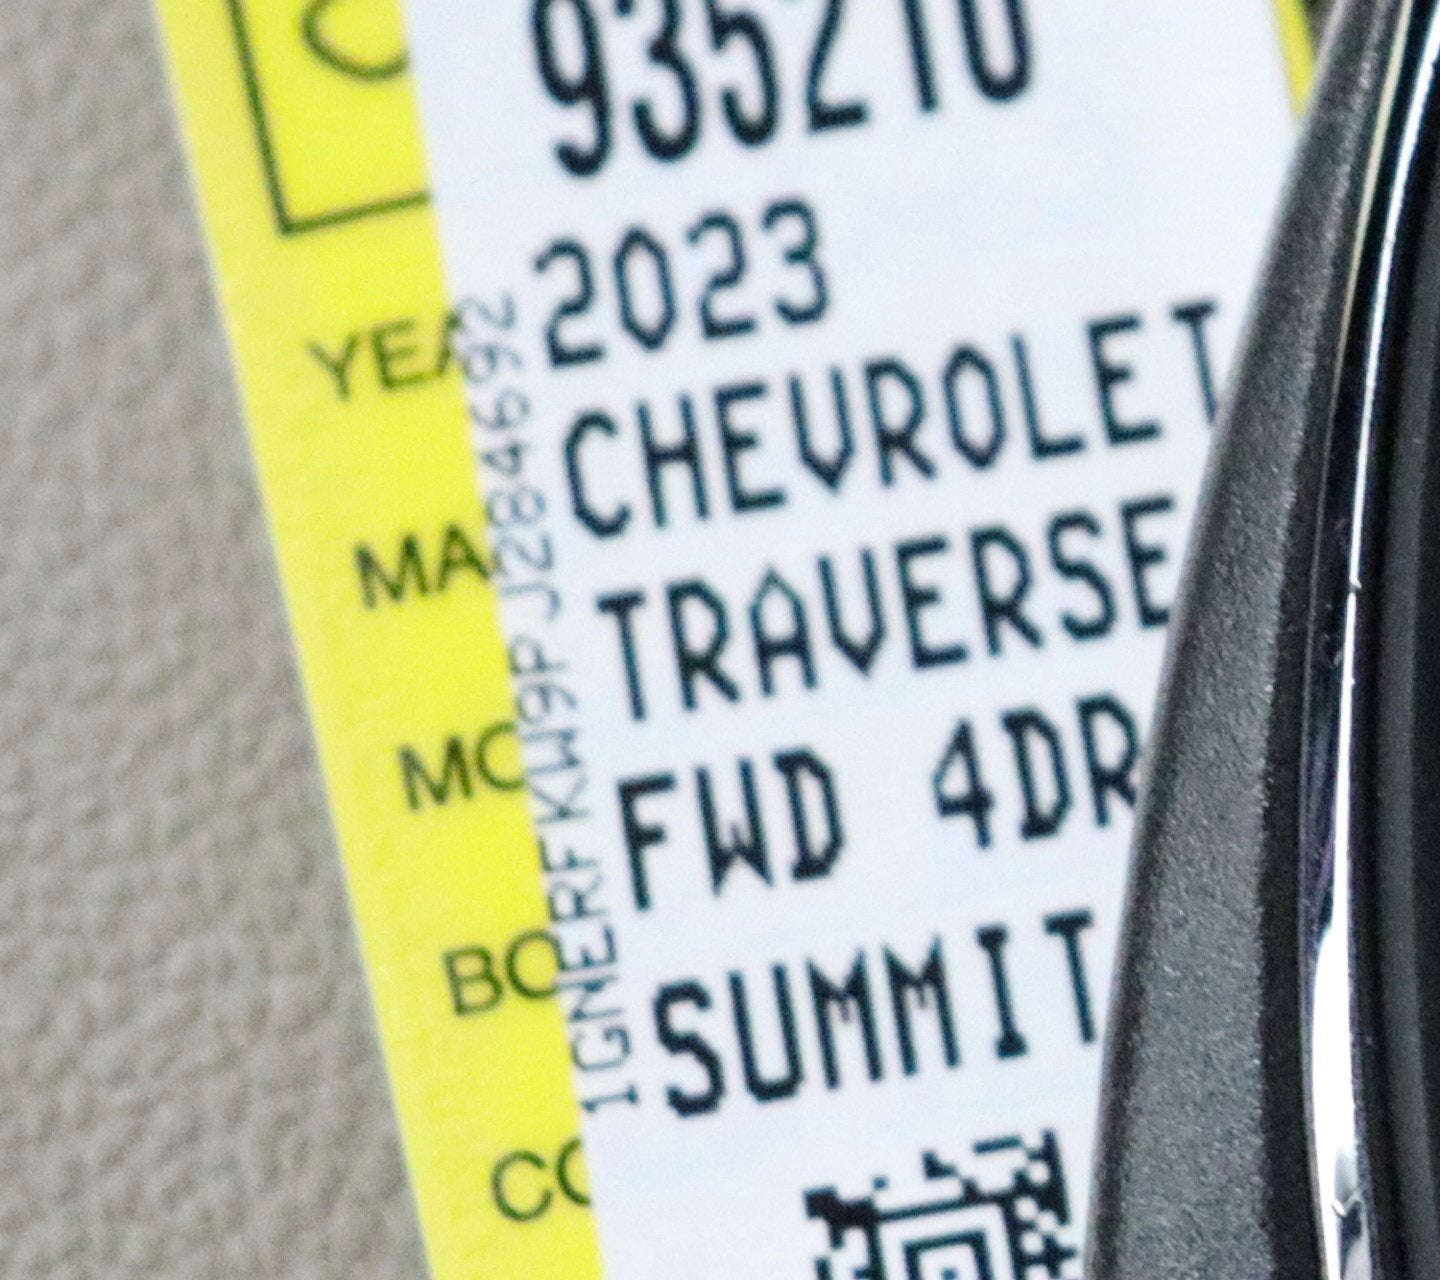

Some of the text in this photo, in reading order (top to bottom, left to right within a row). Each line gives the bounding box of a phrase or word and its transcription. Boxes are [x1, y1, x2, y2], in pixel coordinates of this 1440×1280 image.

[536, 200, 827, 368] 2023
[564, 302, 1217, 538] CHEVROLET
[598, 496, 1173, 719] TRAVERSE
[618, 695, 1137, 909] FWD 4DR
[653, 911, 1093, 1117] SUMMIT
